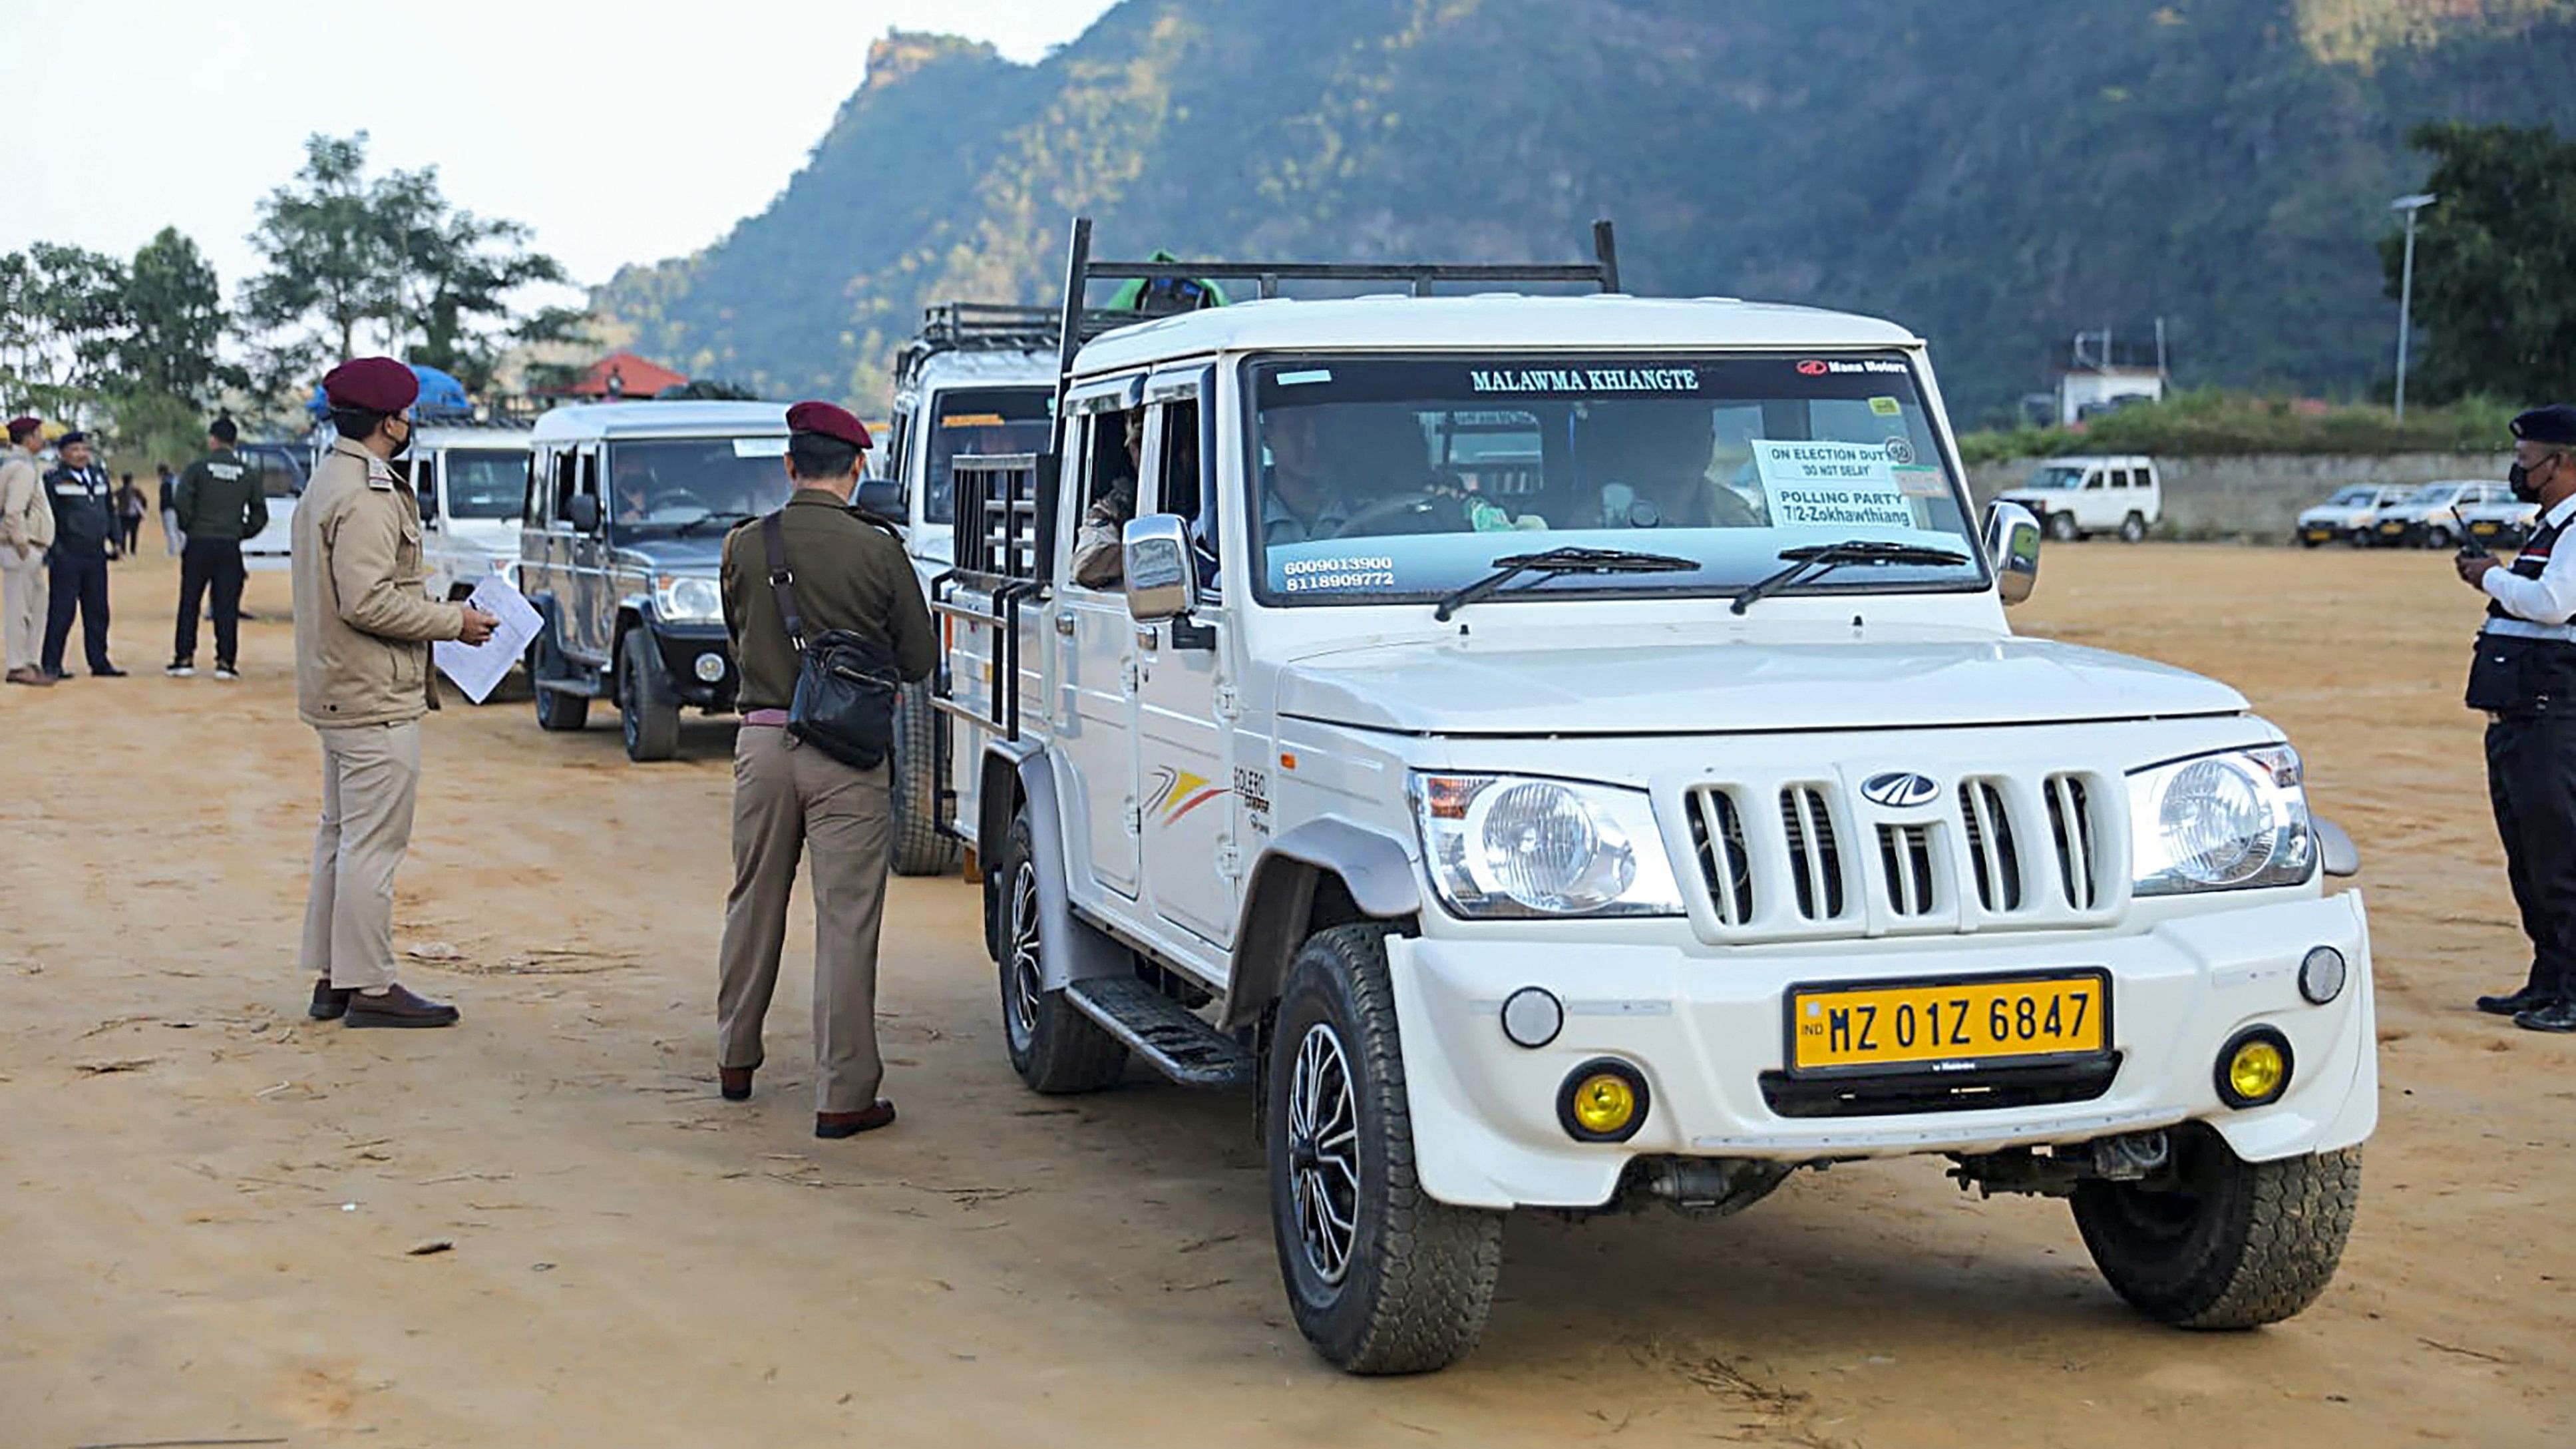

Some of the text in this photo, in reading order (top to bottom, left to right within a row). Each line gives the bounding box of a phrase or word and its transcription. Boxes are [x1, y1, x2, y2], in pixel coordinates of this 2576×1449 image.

[1471, 369, 1698, 391] MALAWMA KHIANGTE
[1771, 449, 1791, 460] ON
[1794, 449, 1856, 461] ELECTION
[1820, 466, 1839, 477] NOT
[1781, 491, 1903, 506] POLLING PARTY
[1284, 557, 1393, 575] 6009013900
[1286, 572, 1394, 591] 8118909772
[1801, 1023, 1824, 1036] IND
[1829, 993, 2089, 1053] MZ 01Z 6847
